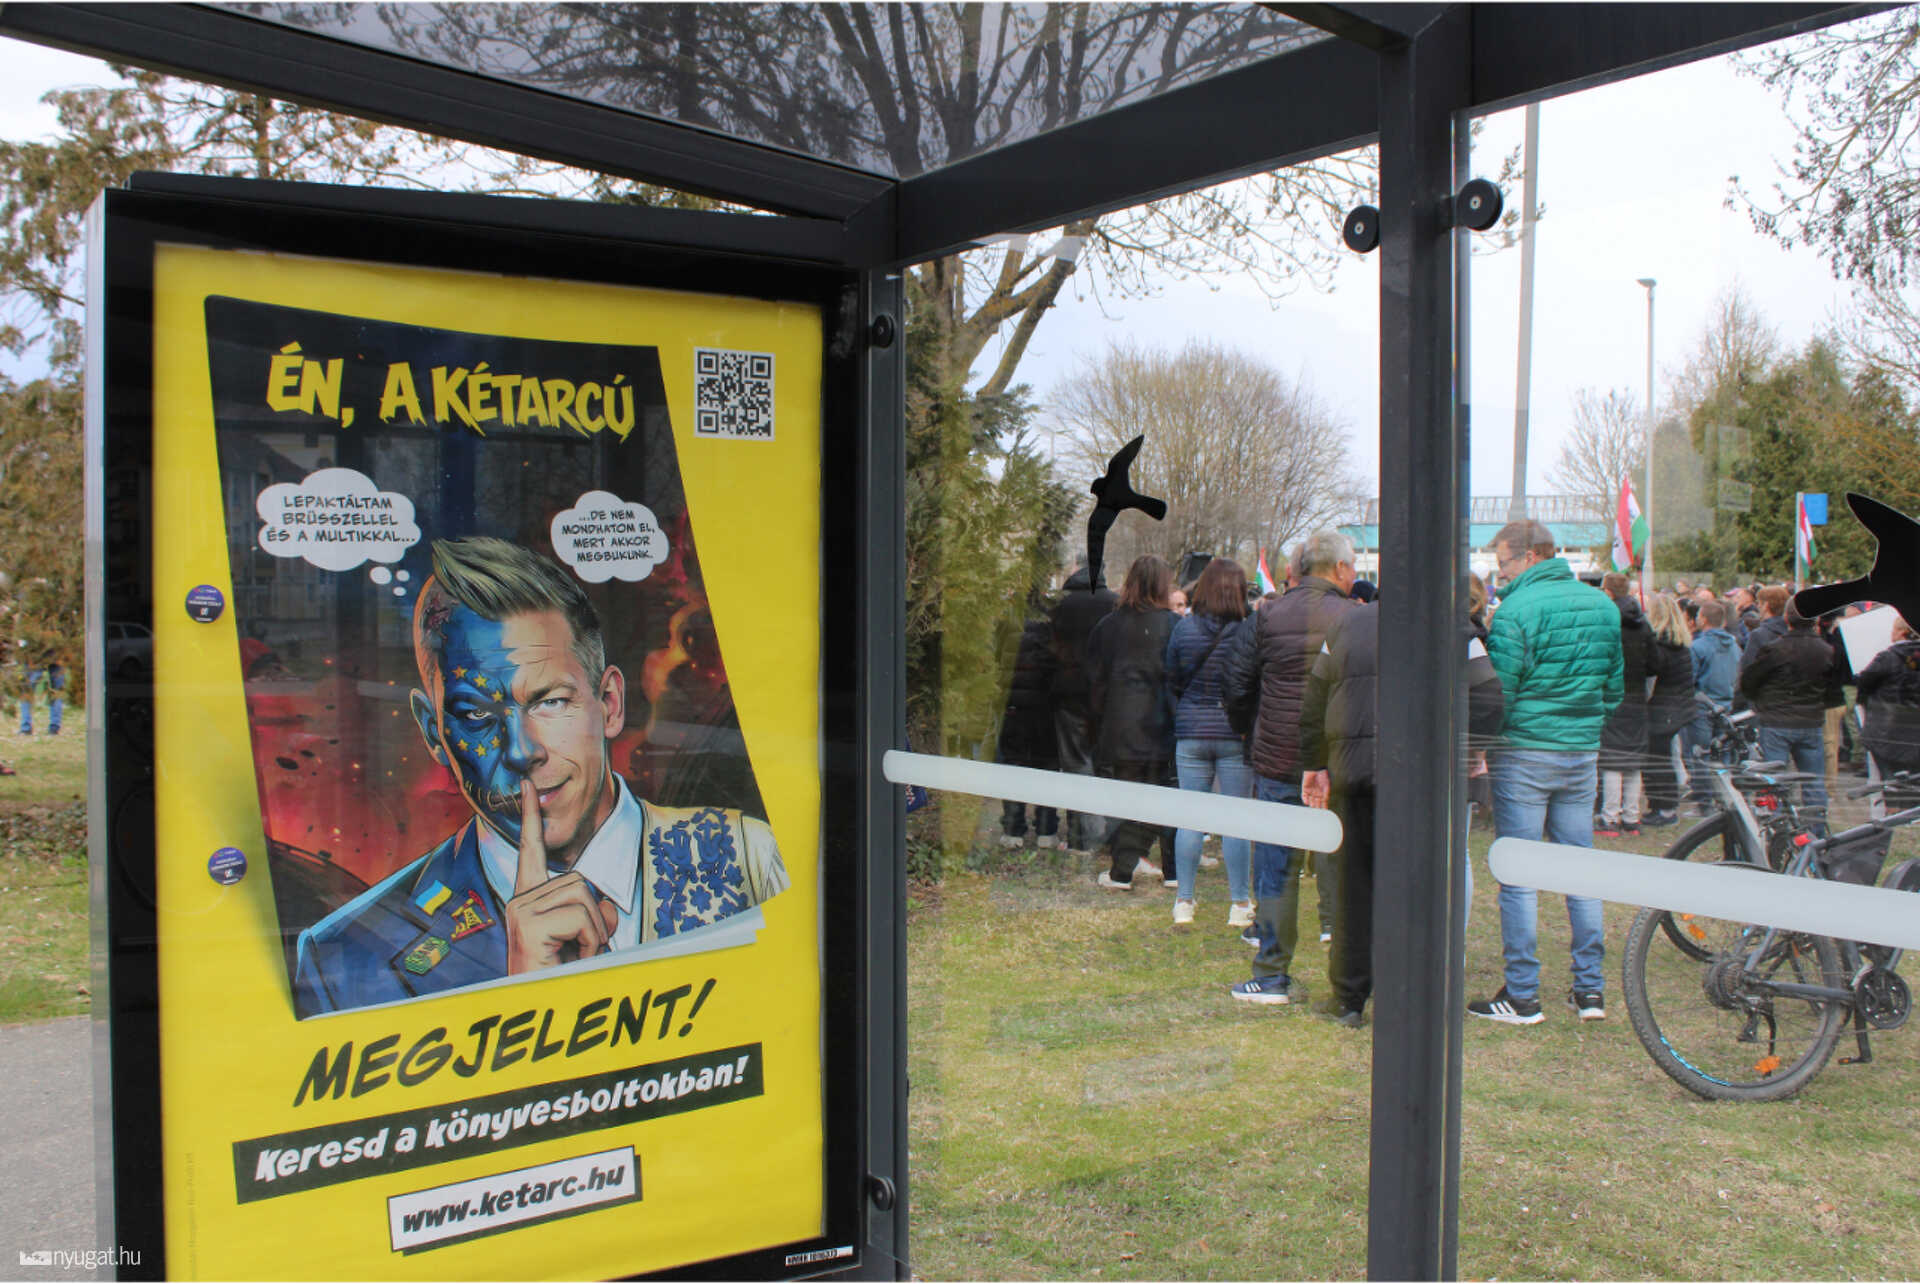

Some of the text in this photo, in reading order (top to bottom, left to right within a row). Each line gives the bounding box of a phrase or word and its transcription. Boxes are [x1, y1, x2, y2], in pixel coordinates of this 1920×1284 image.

[266, 341, 635, 443] ÉN, A KÉTARCÚ
[283, 494, 393, 509] LEPAKTÁLTAM
[282, 511, 399, 526] BRÜSSZELLEL
[611, 509, 636, 520] NEM
[266, 527, 416, 543] ÉS A MULTIKKAL...
[562, 522, 655, 535] MONDHATOM EL,
[573, 536, 650, 548] MERT AKKOR
[293, 978, 717, 1108] MEGJELENT!
[255, 1055, 749, 1181] Keresd a könyvesboltokban!
[403, 1165, 625, 1233] www.ketarc.hu
